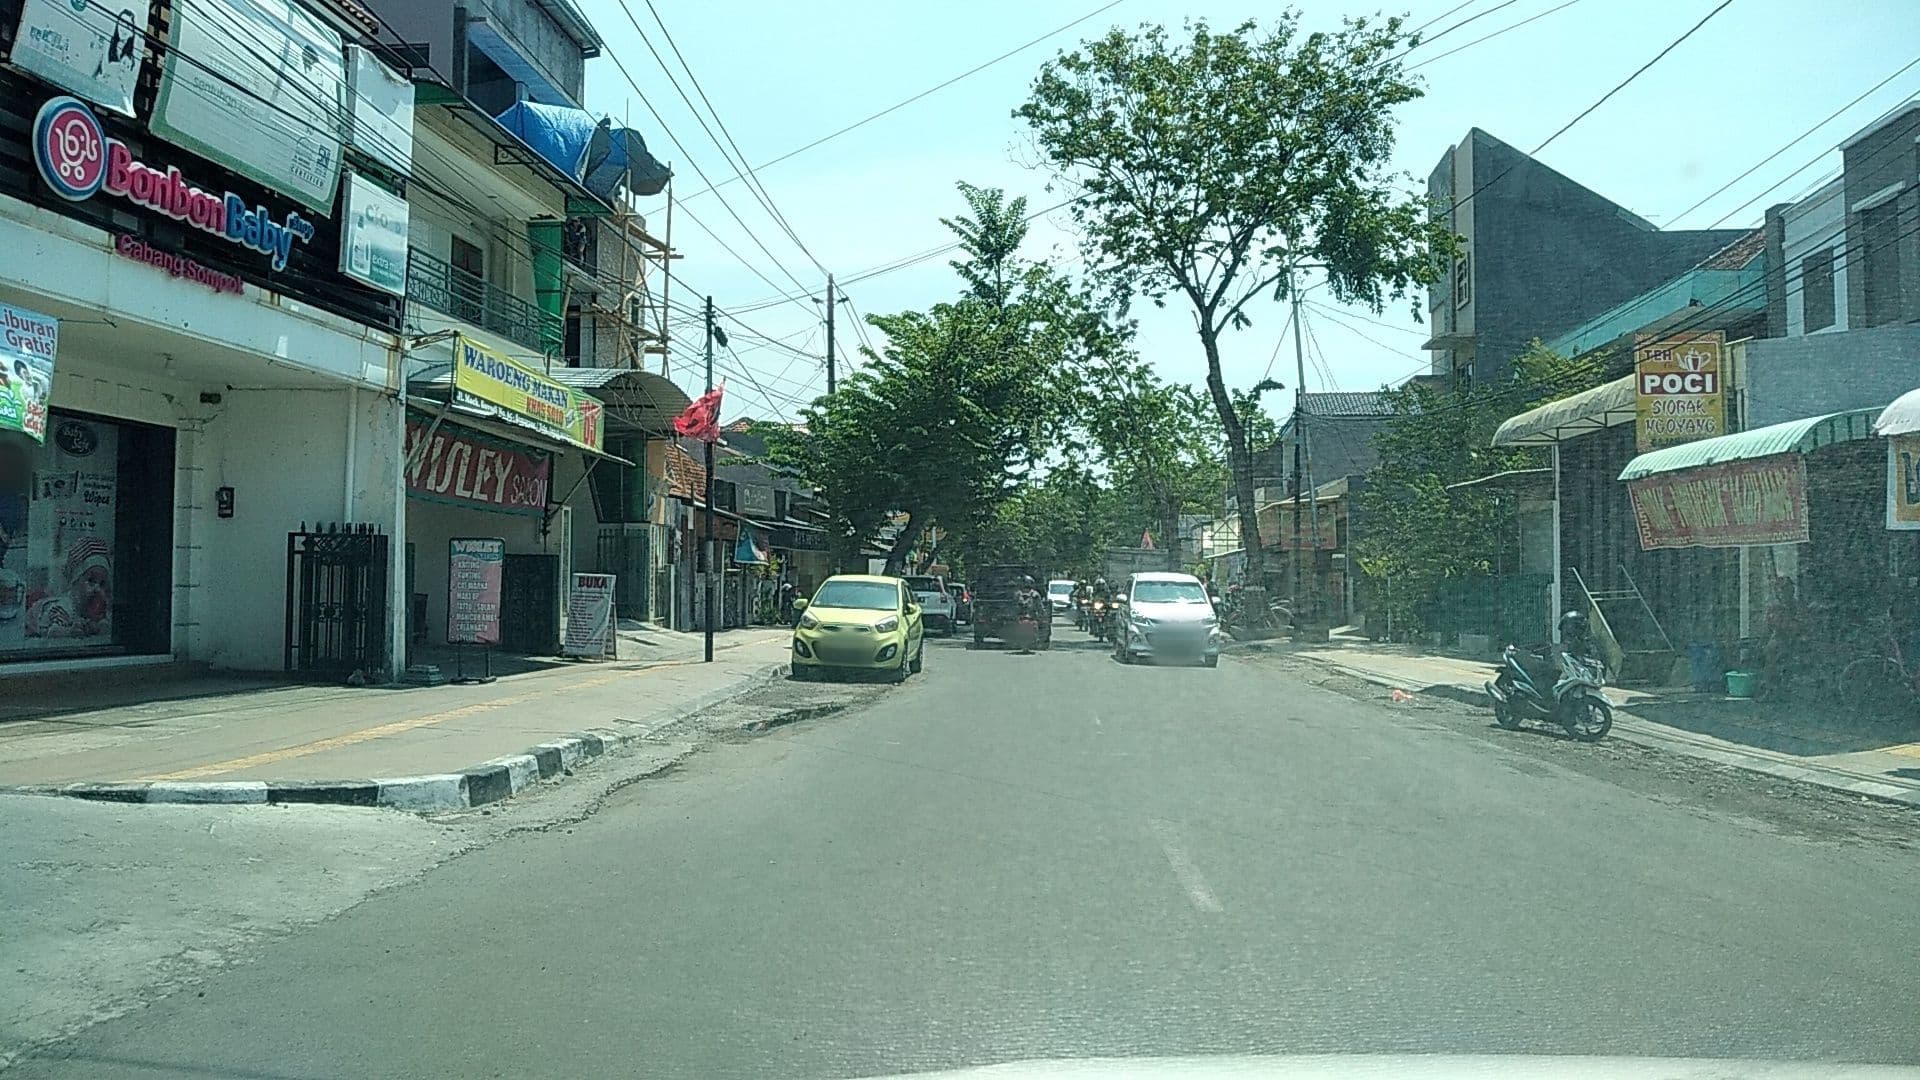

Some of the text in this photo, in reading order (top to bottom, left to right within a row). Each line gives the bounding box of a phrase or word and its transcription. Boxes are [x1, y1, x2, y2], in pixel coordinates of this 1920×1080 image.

[116, 233, 244, 295] Cabang Sompok
[0, 308, 55, 339] iburan
[1644, 349, 1673, 361] TEH
[463, 344, 569, 407] WAROENG MAKAN
[1644, 373, 1713, 394] POCI
[1652, 399, 1706, 415] SIOBAK
[1645, 417, 1716, 434] NGOYANG
[510, 475, 548, 507] SALON
[578, 575, 608, 589] BUKA
